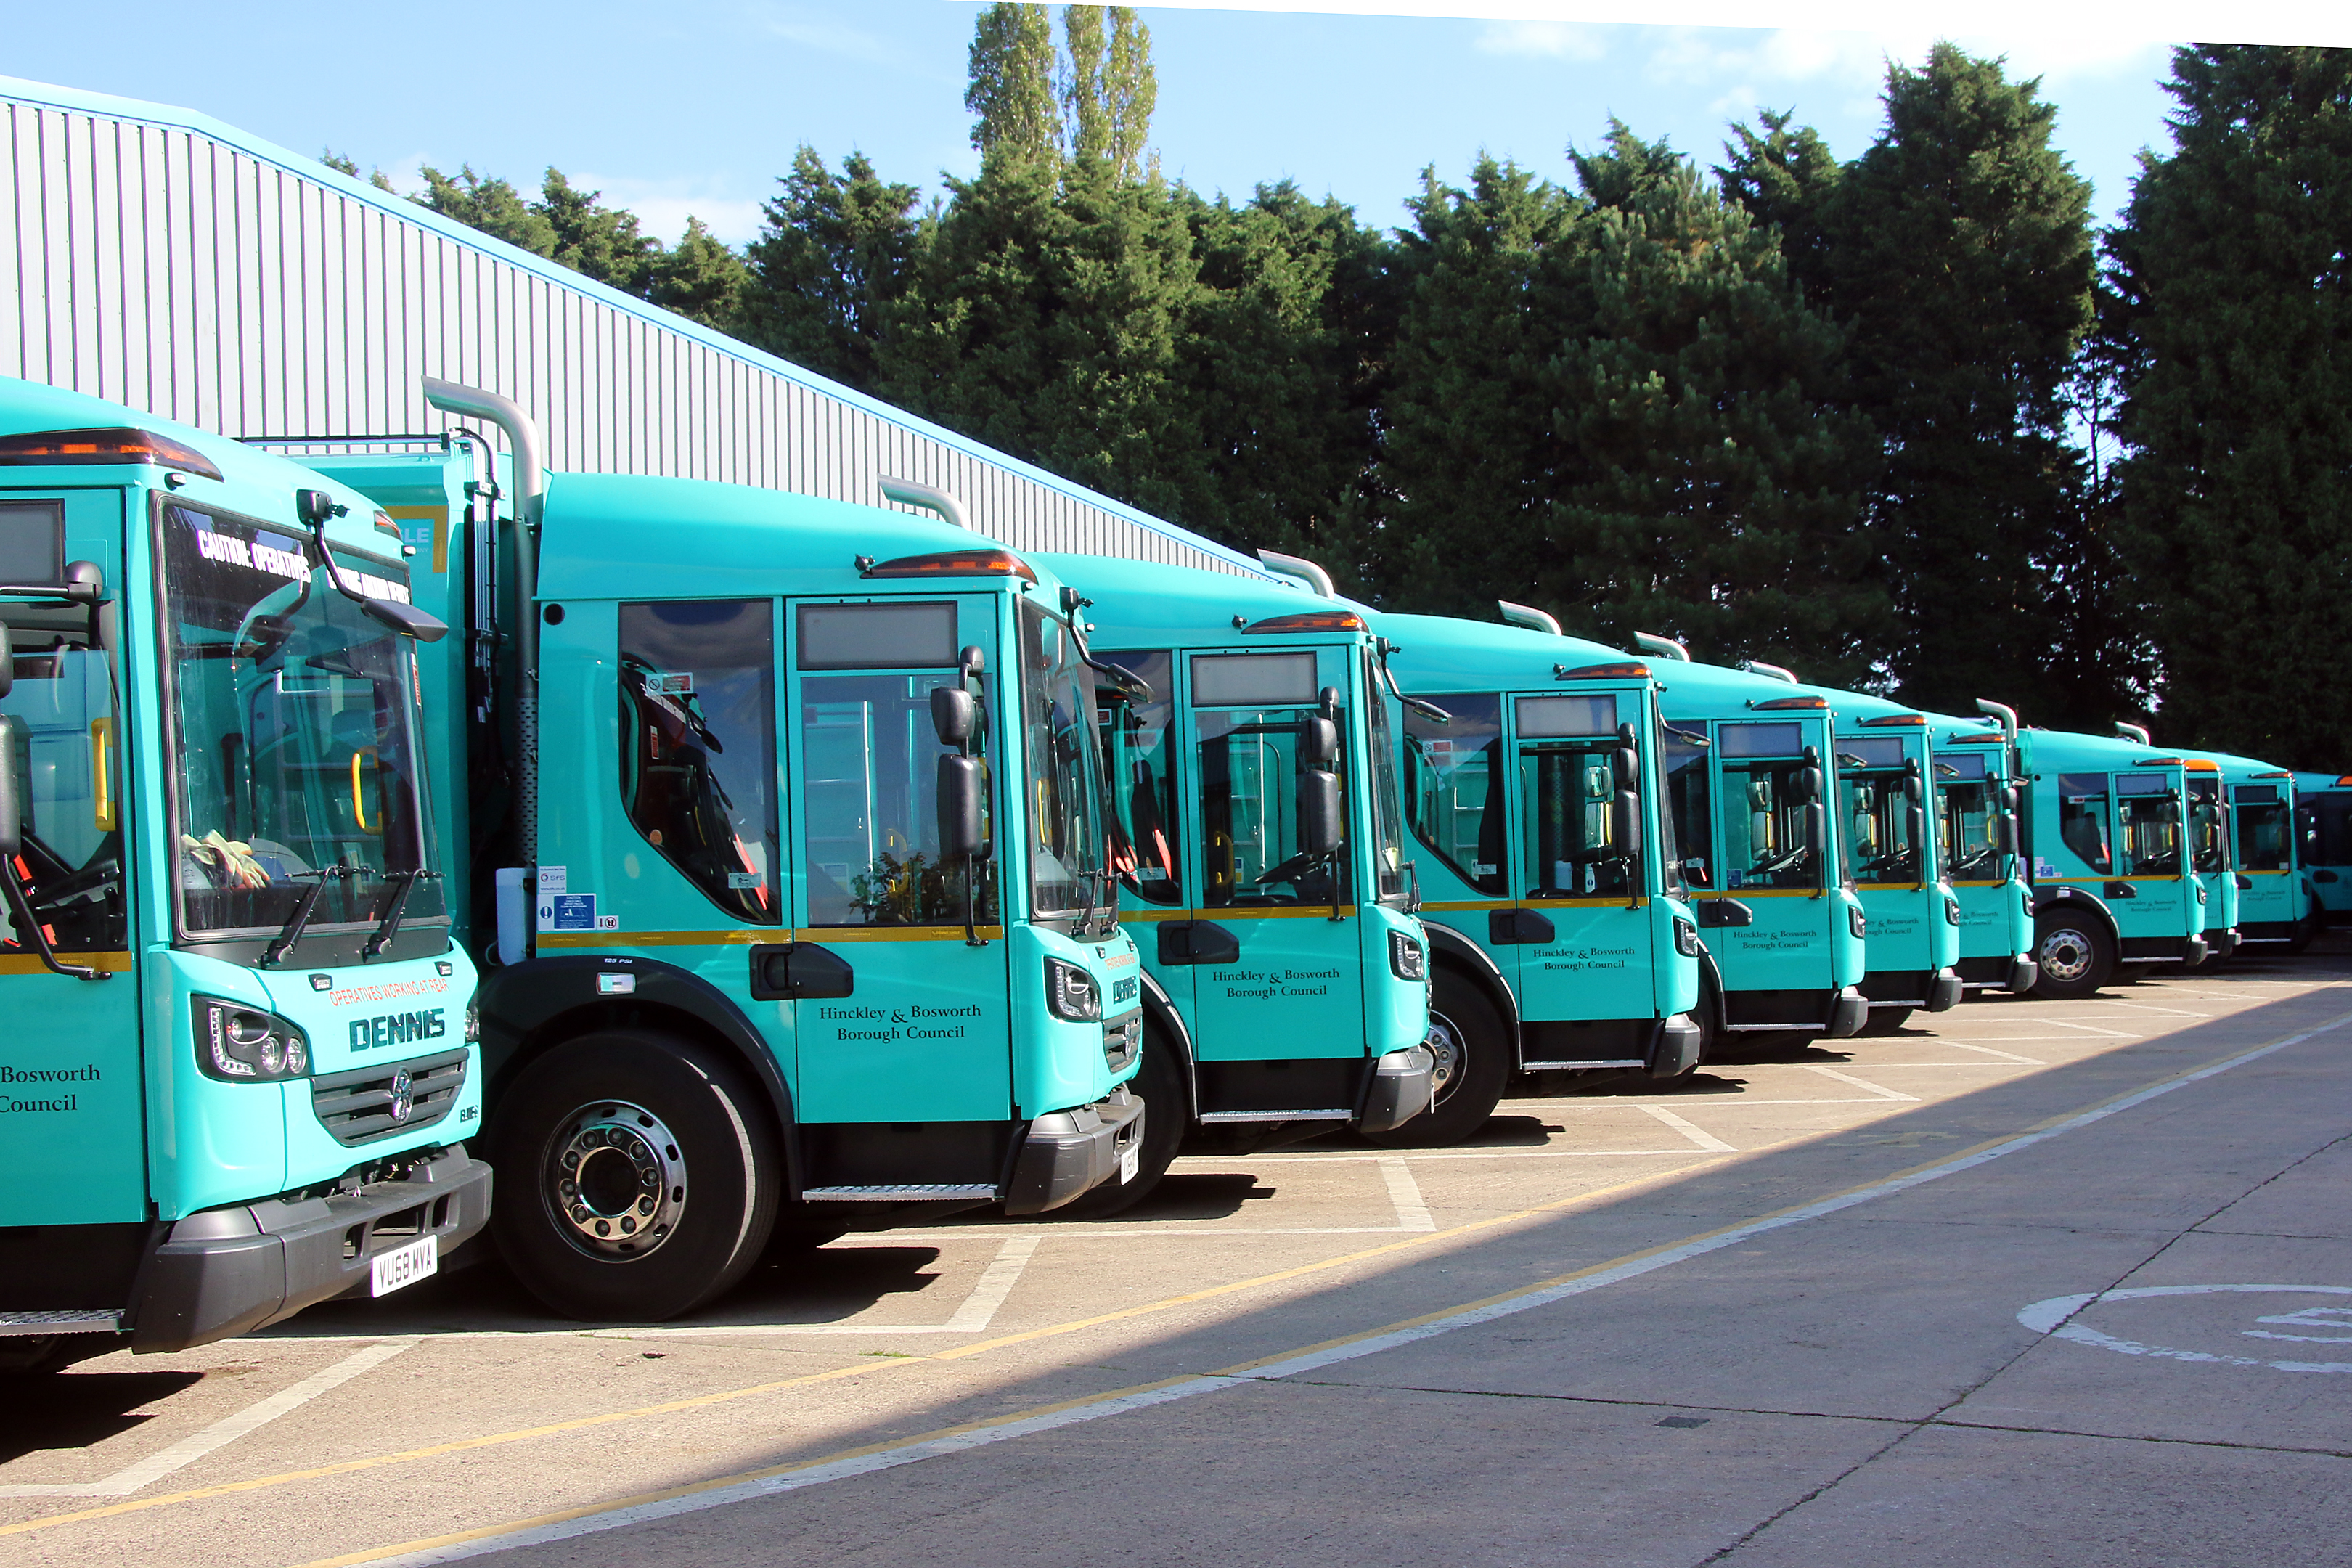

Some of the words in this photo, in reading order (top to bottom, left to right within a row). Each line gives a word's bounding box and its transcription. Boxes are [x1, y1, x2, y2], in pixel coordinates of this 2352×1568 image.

[197, 529, 253, 568] CAUTION:
[250, 542, 311, 583] OPERATIVES
[1533, 949, 1575, 958] Hinckley
[1578, 950, 1588, 959] &
[1591, 947, 1635, 955] Bosworth
[1545, 961, 1584, 971] Borough
[1588, 960, 1625, 969] Council
[1213, 971, 1265, 983] Hinckley
[1269, 972, 1282, 984] &
[1285, 968, 1339, 979] Bosworth
[329, 985, 383, 1006] OPERATIVES
[381, 981, 420, 999] WORKING
[420, 980, 429, 995] AT
[428, 978, 449, 992] REAR
[1227, 987, 1276, 1000] Borough
[1281, 985, 1327, 996] Council
[820, 1007, 886, 1023] Hinckley
[891, 1009, 908, 1024] &
[911, 1005, 981, 1018] Bosworth
[349, 1008, 445, 1053] DENNIS
[837, 1027, 900, 1044] Borough
[907, 1026, 965, 1039] Council
[1, 1064, 101, 1082] Bosworth
[0, 1094, 77, 1112] Council
[380, 1252, 409, 1289] VU68
[412, 1243, 432, 1276] MVA
